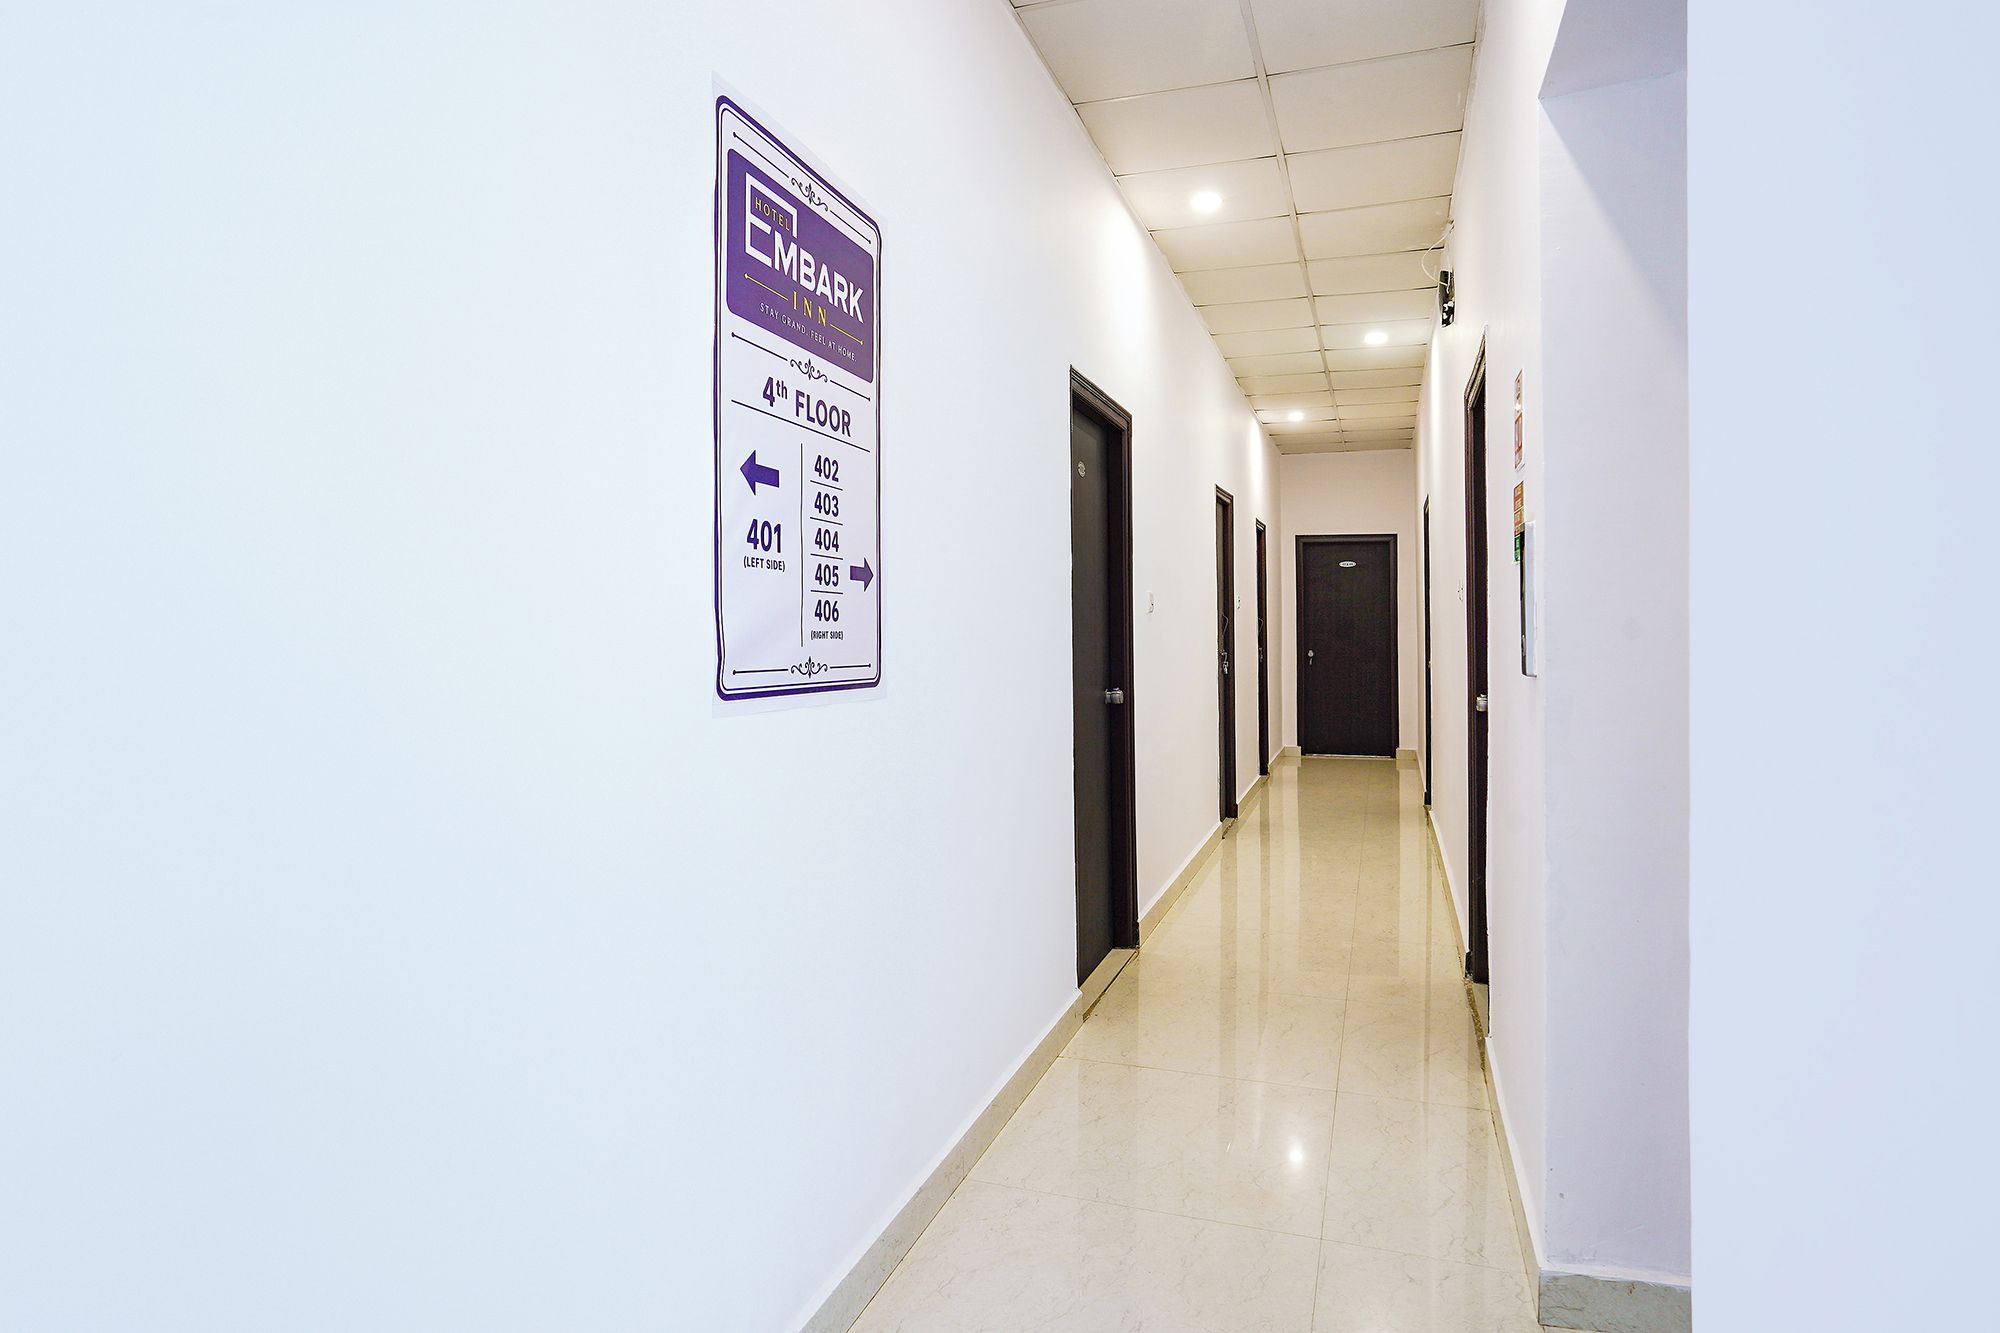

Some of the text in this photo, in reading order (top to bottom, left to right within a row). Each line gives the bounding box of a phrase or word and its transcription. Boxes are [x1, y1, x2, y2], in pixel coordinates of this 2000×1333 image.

[755, 196, 791, 232] HOTEL
[745, 172, 864, 324] EMBARK
[793, 291, 827, 327] INN
[759, 302, 779, 319] STAY
[810, 330, 826, 347] FEEL
[827, 338, 836, 350] AT
[763, 376, 851, 437] 4th FLOOR
[814, 455, 839, 482] 402
[814, 491, 839, 517] 403
[746, 518, 782, 553] 401
[814, 527, 839, 552] 404
[743, 555, 786, 572] (LEFT SIDE)
[814, 563, 839, 587] 405
[814, 599, 839, 622] 406
[810, 630, 844, 640] (RIGHT SIDE)
